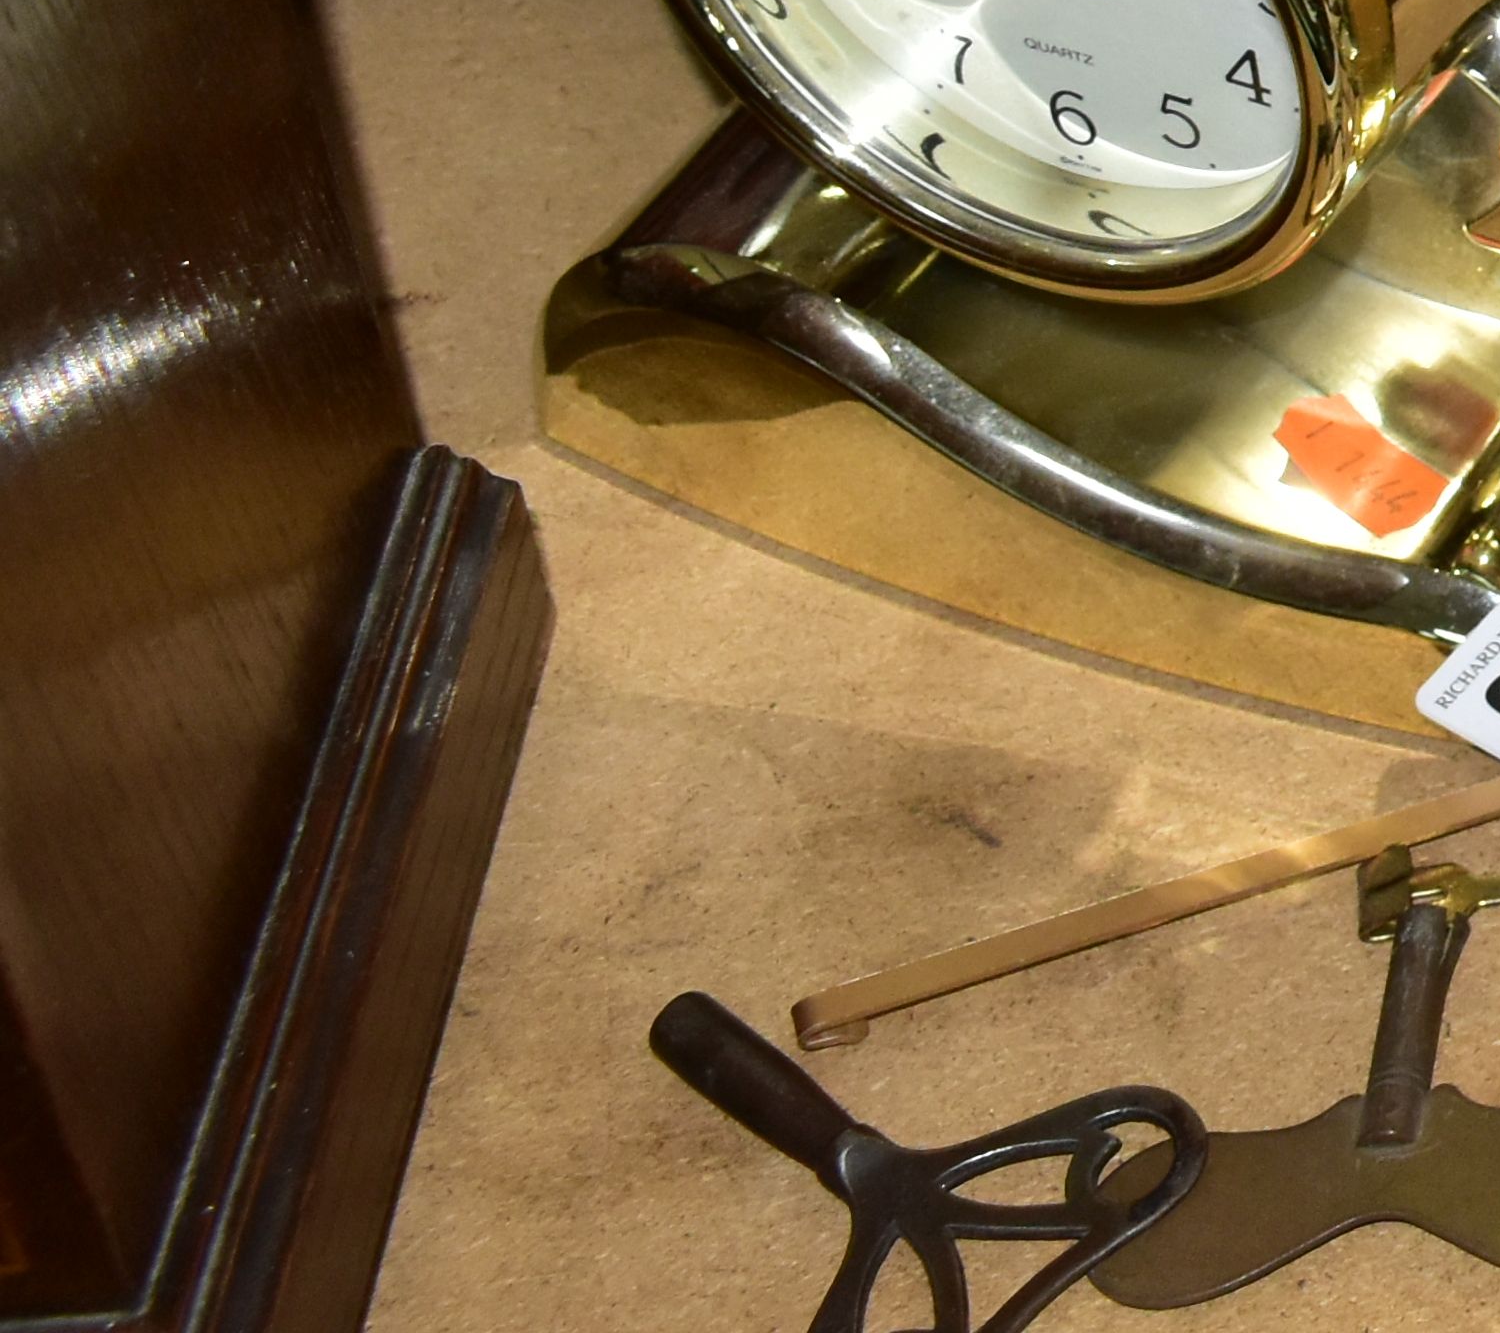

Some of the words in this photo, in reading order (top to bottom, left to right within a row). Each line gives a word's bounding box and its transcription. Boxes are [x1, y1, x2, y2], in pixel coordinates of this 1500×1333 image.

[951, 35, 974, 85] 7
[1023, 36, 1095, 67] QUARTZ
[1224, 47, 1273, 109] 4
[1049, 89, 1097, 147] 6
[1159, 92, 1201, 150] 5
